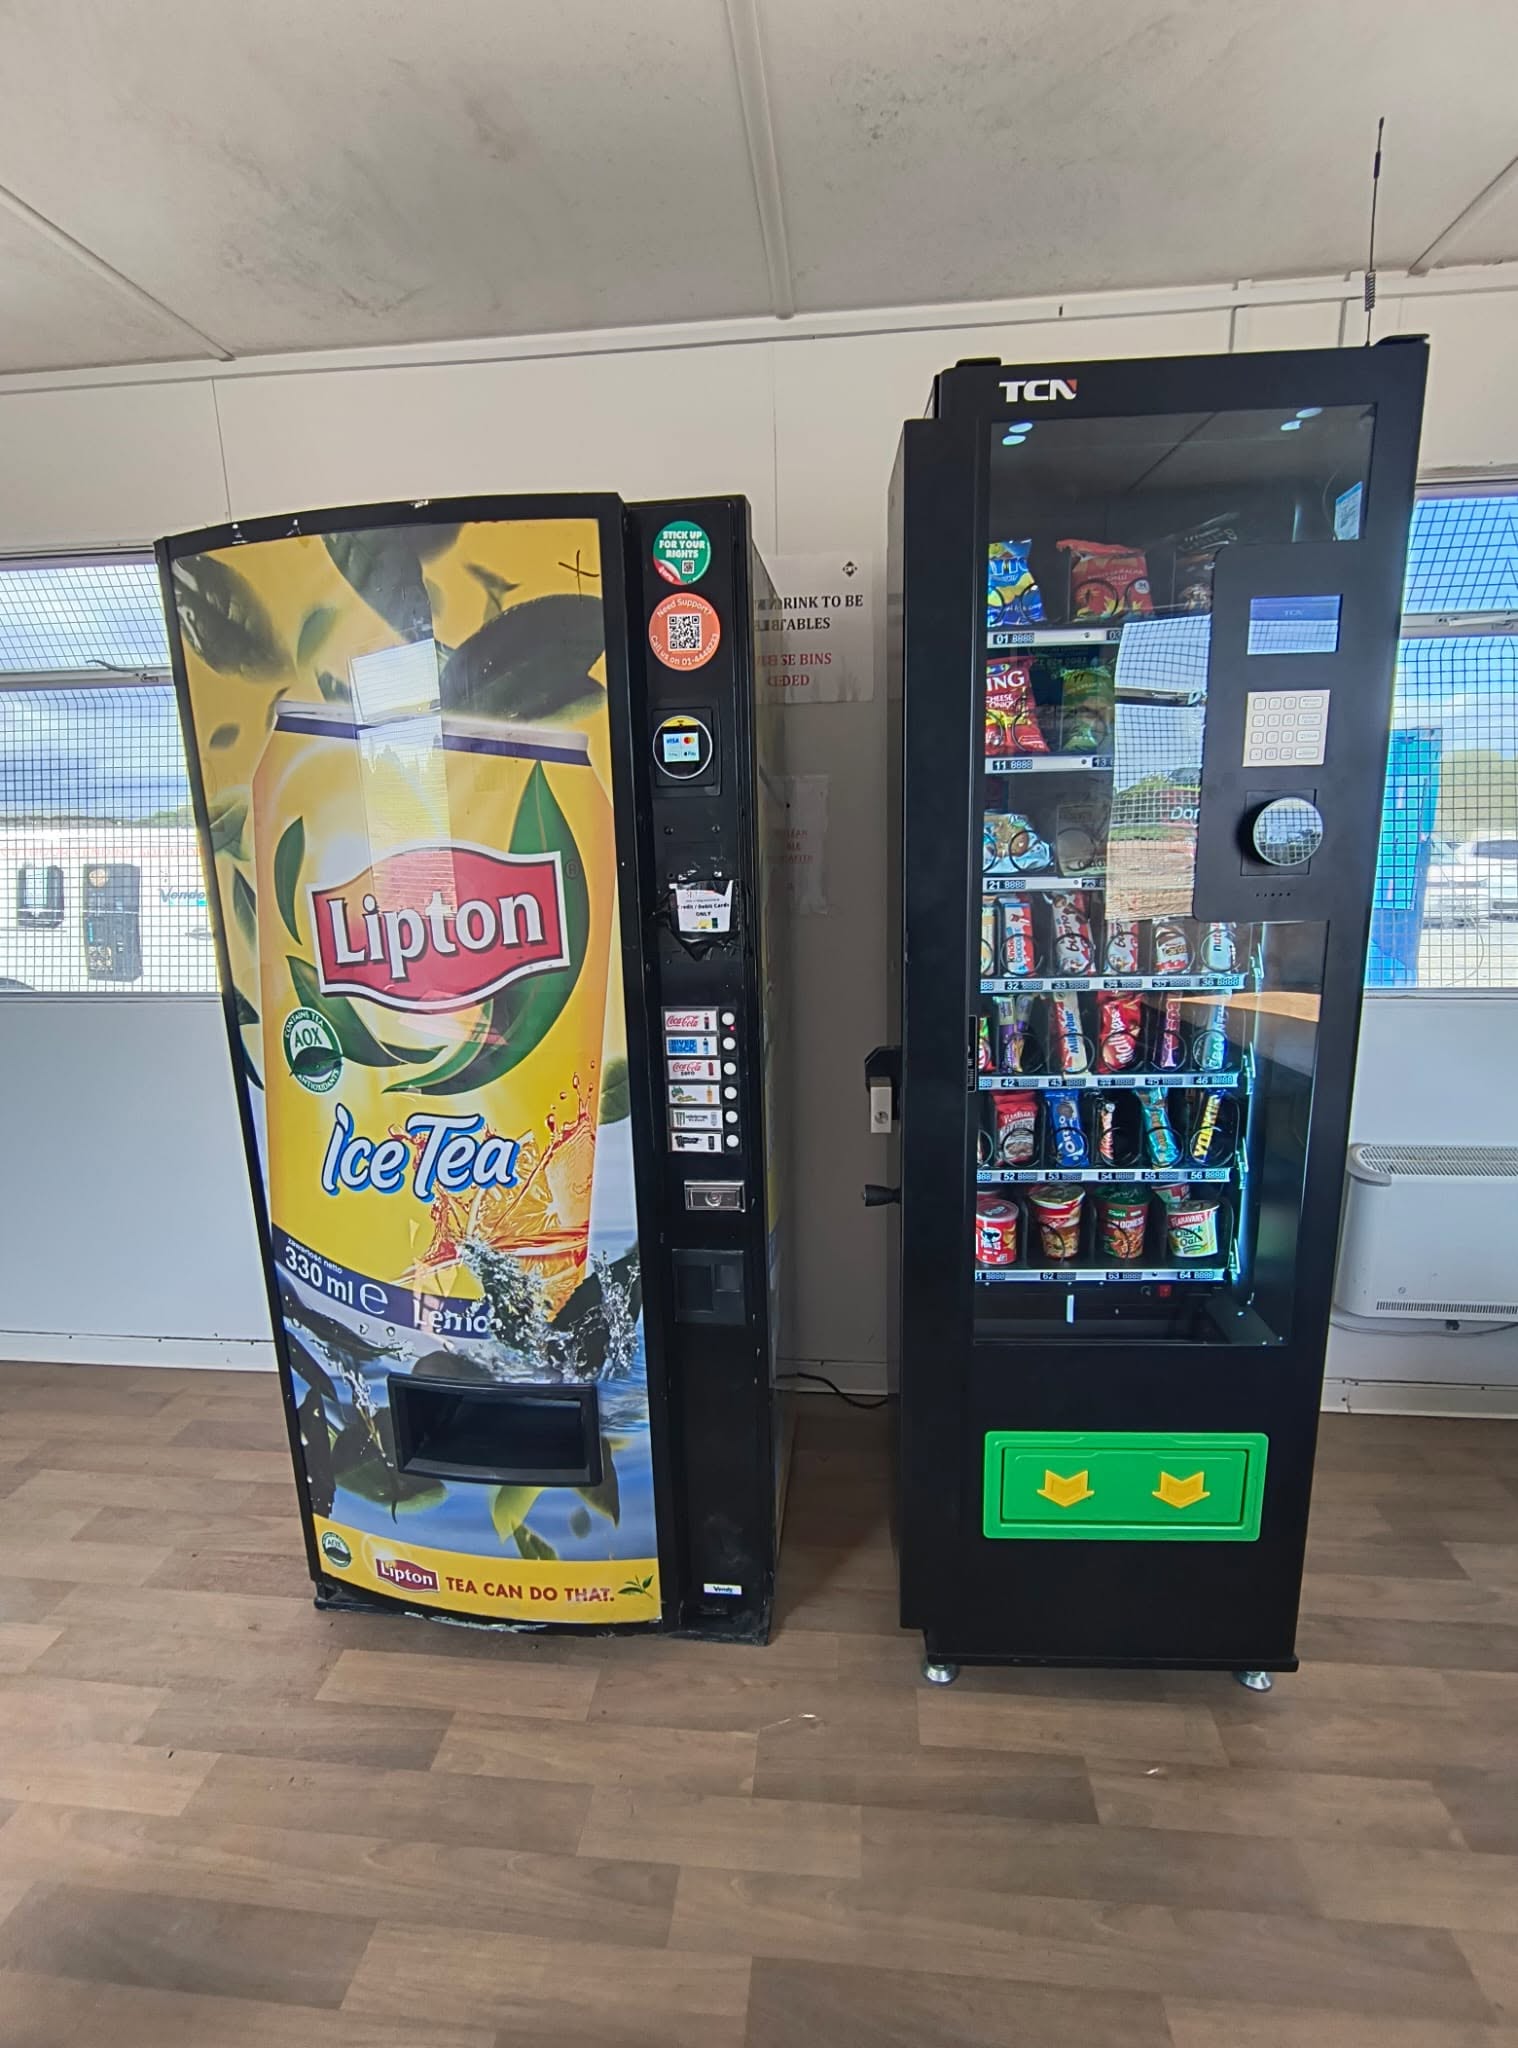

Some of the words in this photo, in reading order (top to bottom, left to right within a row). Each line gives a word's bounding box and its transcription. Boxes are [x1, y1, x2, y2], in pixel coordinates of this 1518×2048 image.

[999, 379, 1078, 402] TCN
[659, 540, 677, 549] FOR
[680, 539, 705, 549] YOUR
[662, 531, 688, 539] STICK
[690, 531, 702, 539] UP
[666, 549, 699, 558] RIGHTS
[657, 599, 677, 618] Need
[783, 597, 818, 609] RINK
[821, 595, 841, 608] TO
[845, 594, 863, 607] BE
[996, 635, 1008, 644] 01
[800, 653, 832, 665] BINS
[986, 671, 1025, 691] ING
[995, 762, 1006, 770] 11
[1170, 806, 1200, 820] Dor
[989, 882, 1000, 890] 21
[326, 891, 545, 982] Lipton
[285, 1011, 310, 1038] CONTAINS
[311, 1013, 324, 1027] TEA
[1065, 1011, 1079, 1054] Milkybar
[294, 1027, 322, 1048] AOX
[298, 1069, 339, 1091] ANTIOXIDANTS
[1003, 1079, 1015, 1087] 42
[321, 1103, 409, 1194] Ice
[405, 1112, 520, 1202] Tea
[1004, 1172, 1015, 1180] 52
[323, 1259, 343, 1274] netto
[285, 1245, 323, 1287] 330
[327, 1274, 353, 1304] ml
[360, 1283, 388, 1315] e
[413, 1299, 496, 1334] Lemo
[380, 1560, 433, 1586] Lipton
[446, 1576, 477, 1595] TEA
[483, 1582, 523, 1599] CAN
[530, 1586, 558, 1602] DO
[564, 1587, 615, 1603] THAT.
